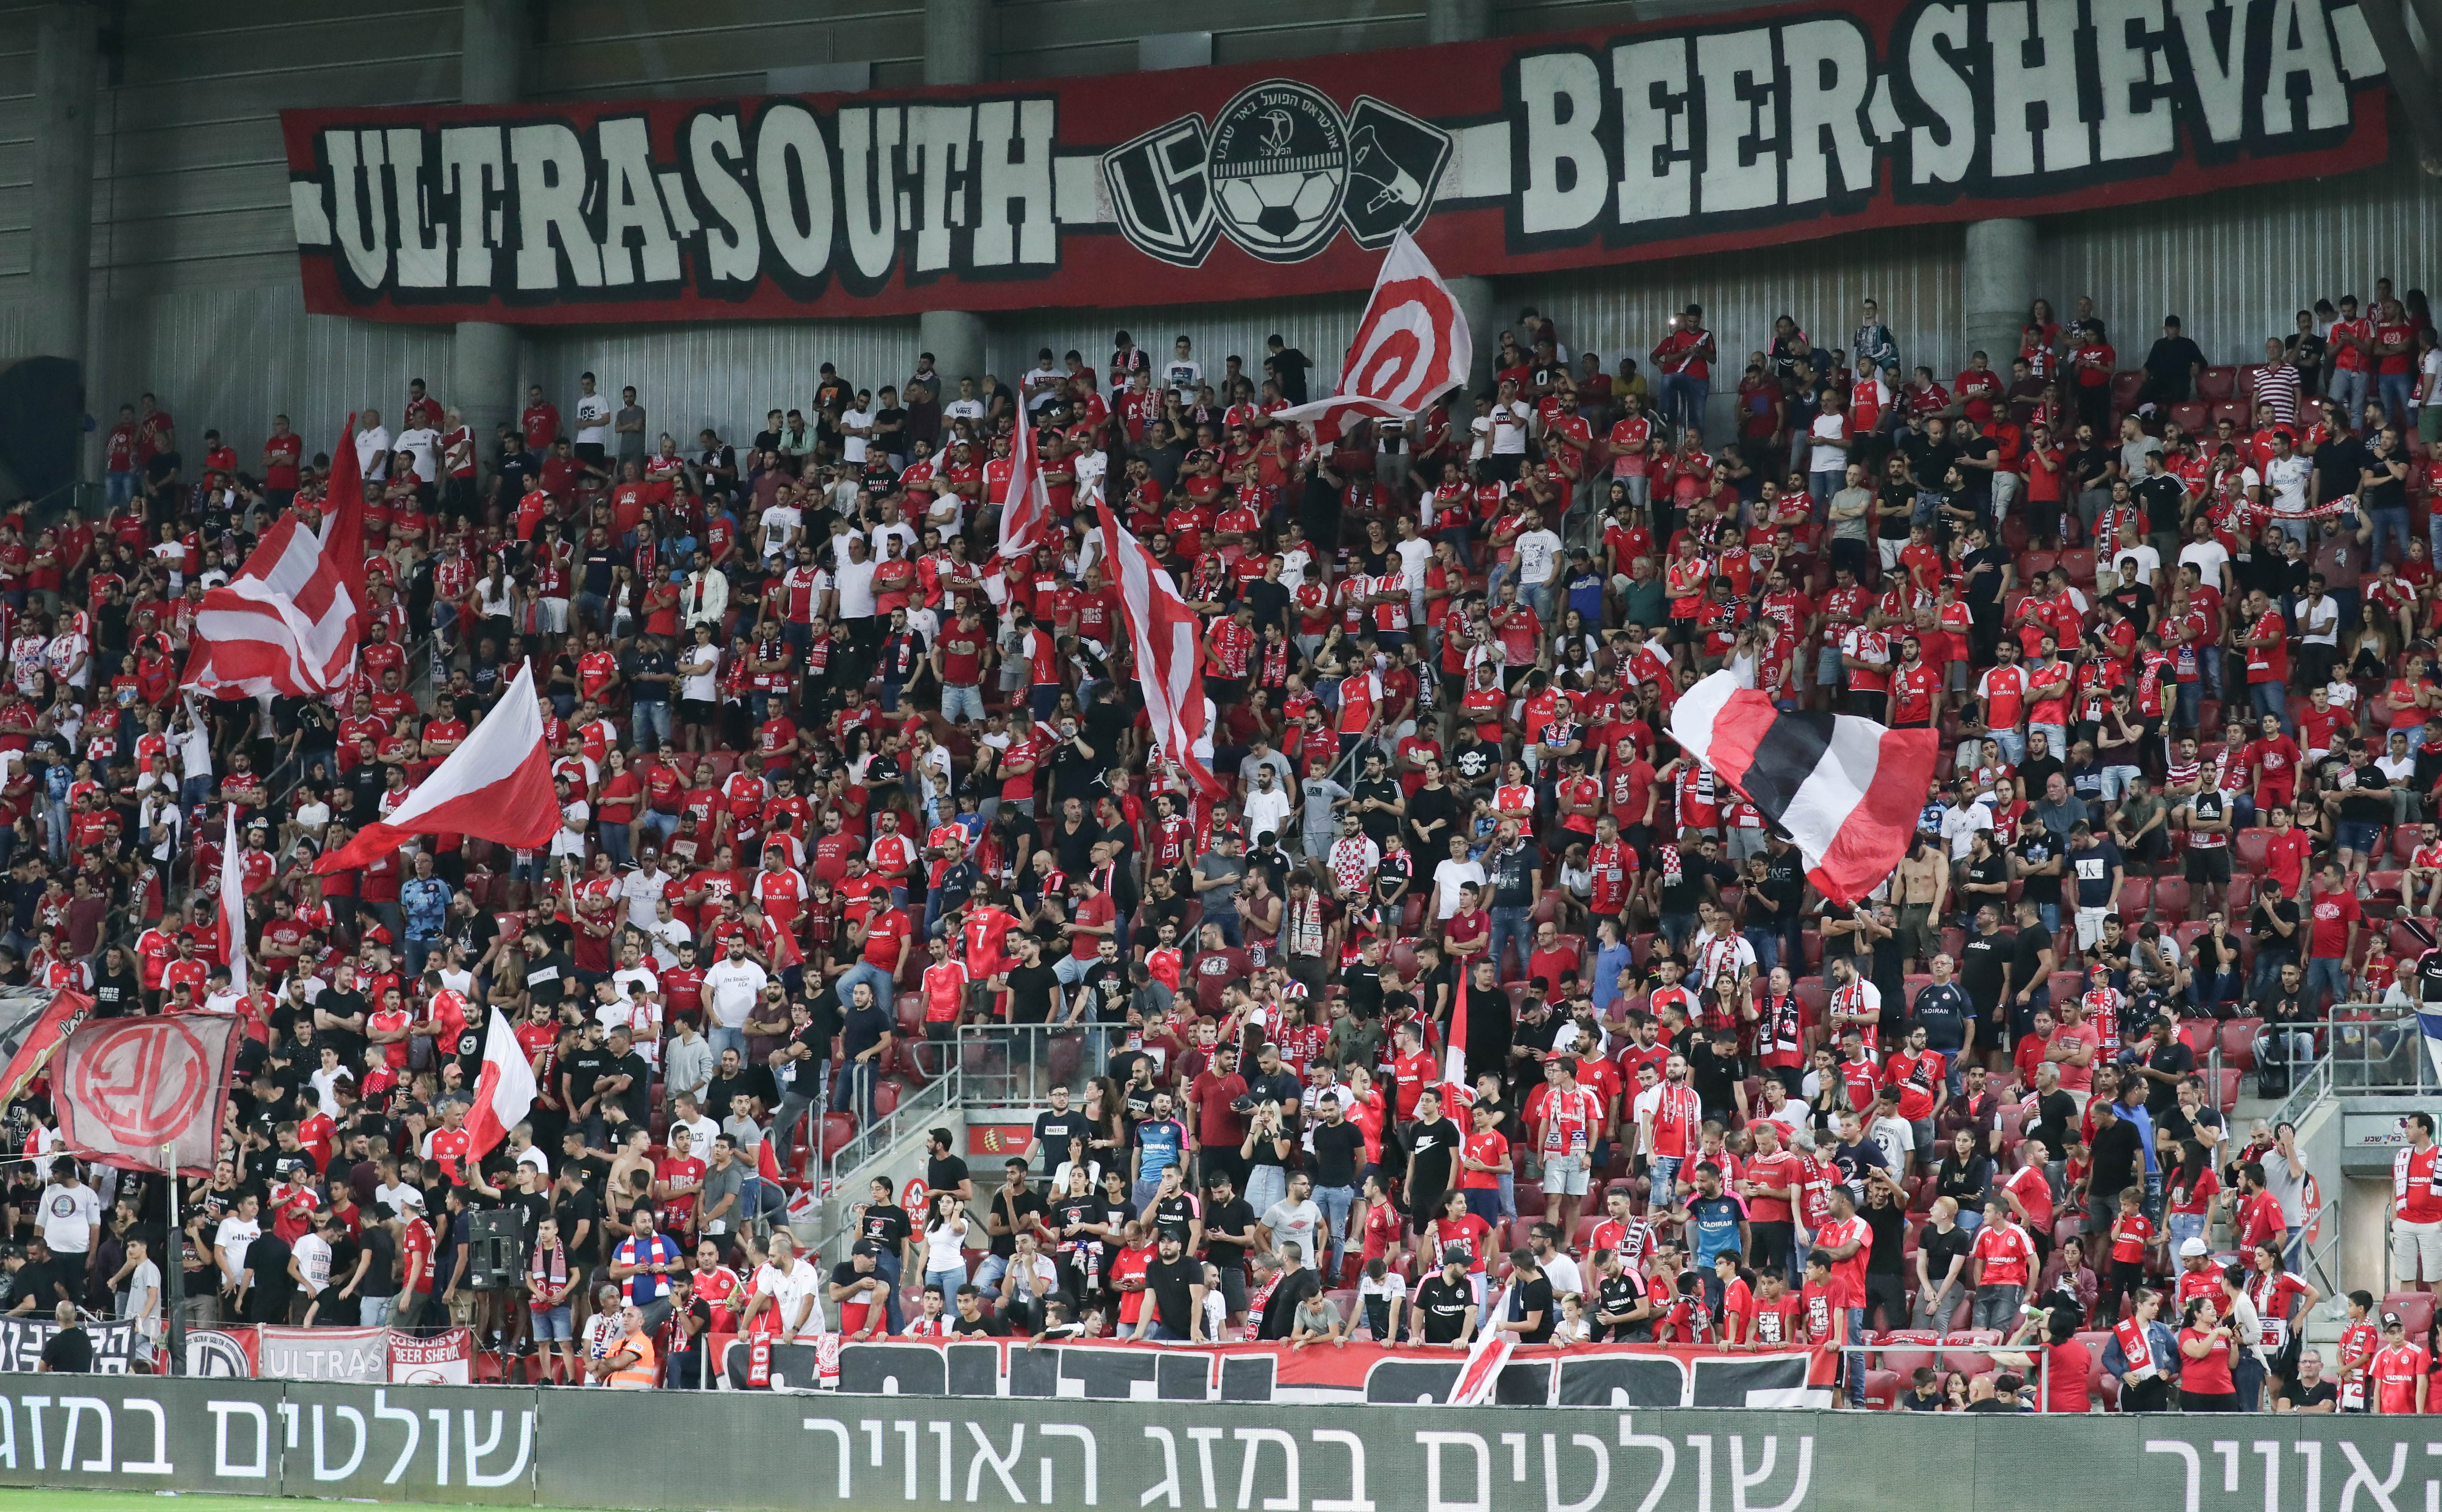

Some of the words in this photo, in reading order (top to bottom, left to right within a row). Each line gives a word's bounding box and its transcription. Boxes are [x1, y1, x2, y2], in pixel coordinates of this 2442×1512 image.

[1260, 92, 1299, 106] הפועל
[1233, 101, 1258, 120] באר
[1520, 19, 1874, 234] BEER
[1908, 0, 2349, 186] SHEVA
[1216, 124, 1234, 160] שבע
[324, 116, 680, 289] ULTRA
[689, 100, 1056, 282] SOUTH
[976, 924, 987, 949] 7
[1968, 941, 1991, 950] adidas
[1343, 956, 1358, 964] HBS
[529, 971, 552, 983] NAUTICA
[1875, 1125, 1894, 1135] WINNERS
[1416, 1136, 1434, 1147] NIKE
[2118, 1232, 2144, 1244] TADIRAN
[1437, 1304, 1465, 1312] TADIRAN
[1607, 1297, 1631, 1308] TADIRAN
[1810, 1299, 1827, 1309] CHA
[1811, 1308, 1828, 1318] MPI
[1759, 1315, 1780, 1324] CHA
[1759, 1324, 1780, 1333] MPI
[270, 1344, 383, 1379] ULTRAS
[2385, 1374, 2412, 1382] TADIRAN
[207, 1388, 533, 1487] שולטים
[803, 1418, 1098, 1507] האוויר
[1416, 1413, 1814, 1512] שולטים
[1140, 1426, 1376, 1512] במזג
